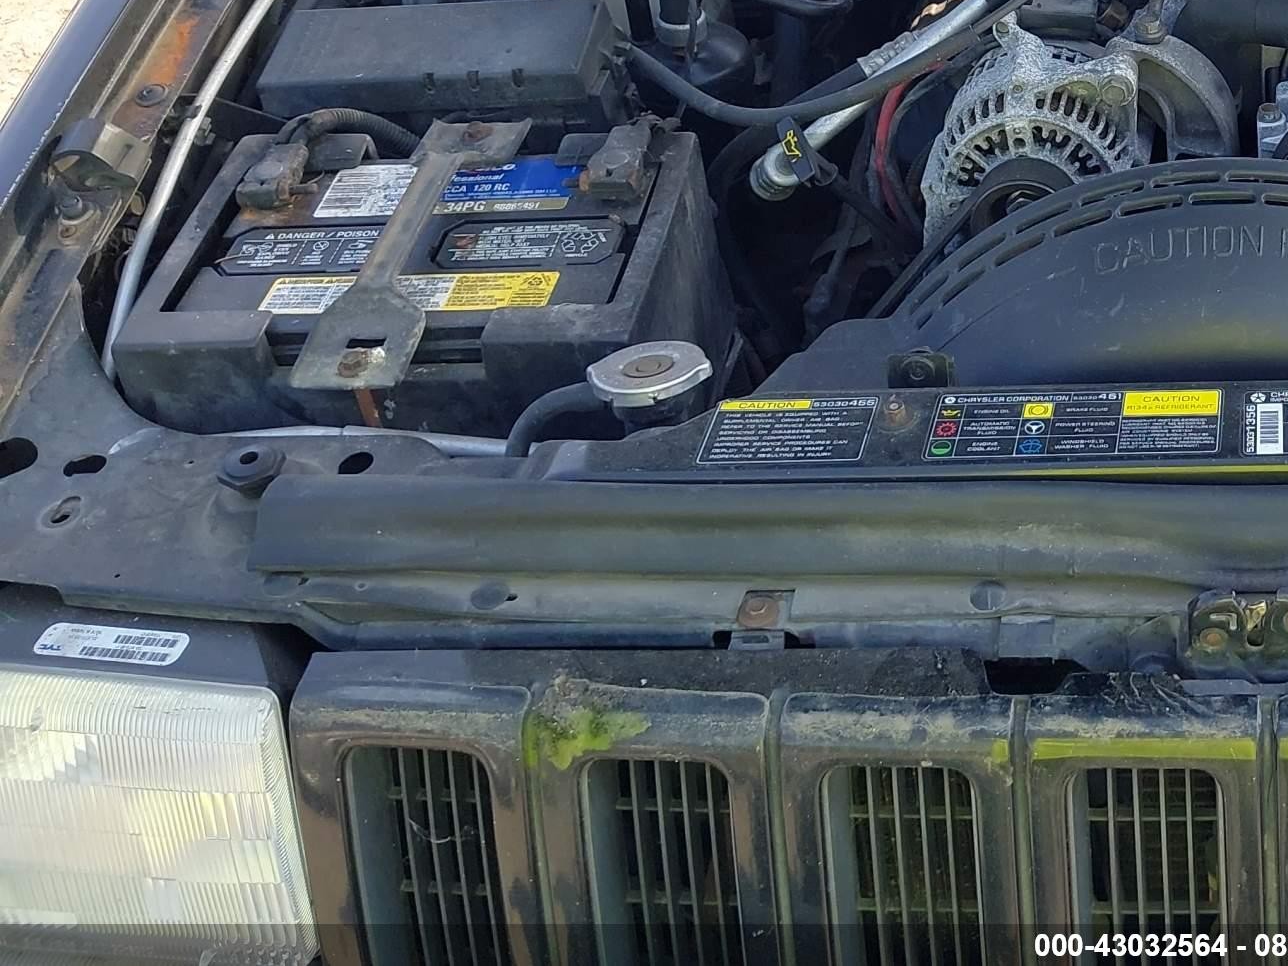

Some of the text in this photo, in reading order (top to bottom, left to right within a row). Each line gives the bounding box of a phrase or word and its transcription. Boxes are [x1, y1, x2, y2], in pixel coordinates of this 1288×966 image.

[494, 183, 511, 191] RC
[444, 201, 486, 212] 34PG
[277, 232, 325, 240] DANGER
[1095, 226, 1264, 275] CAUTION
